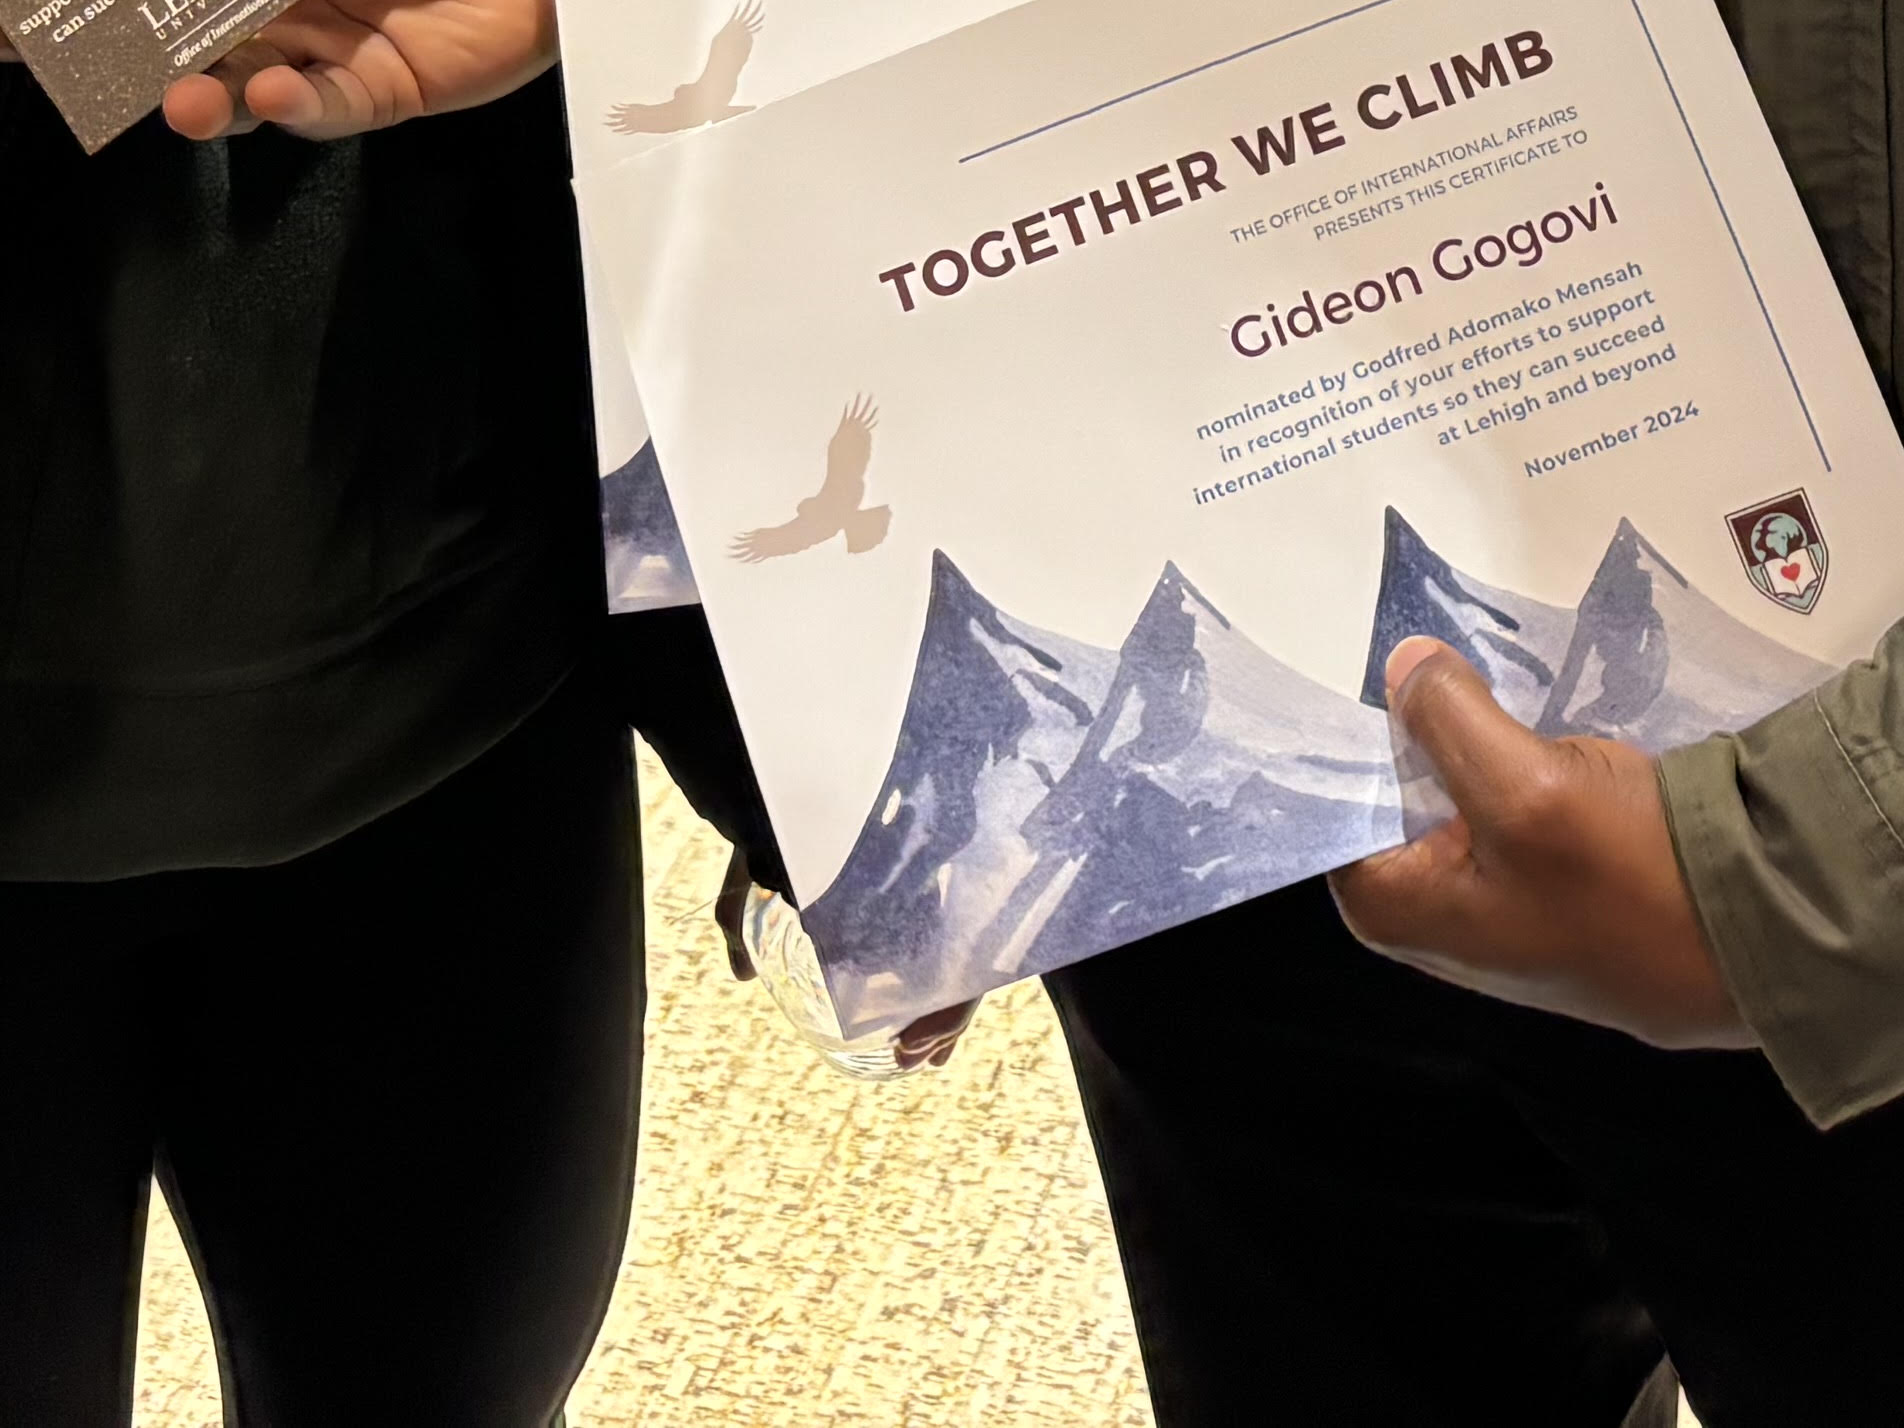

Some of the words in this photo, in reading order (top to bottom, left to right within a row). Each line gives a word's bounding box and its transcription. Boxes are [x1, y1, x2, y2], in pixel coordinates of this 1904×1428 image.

[52, 17, 85, 44] can
[174, 42, 203, 67] Office
[201, 32, 214, 48] of
[879, 150, 1226, 313] TOGETHER
[1230, 102, 1346, 177] WE
[1356, 29, 1554, 131] CLIMB
[1230, 220, 1267, 244] THE
[1269, 195, 1331, 229] OFFICE
[1334, 184, 1358, 204] OF
[1361, 132, 1504, 197] INTERNATIONAL
[1506, 105, 1579, 143] AFFAIRS
[1313, 195, 1404, 241] PRESENTS
[1406, 178, 1447, 204] THIS
[1448, 143, 1561, 191] CERTIFICATE
[1562, 129, 1588, 147] TO
[1230, 264, 1423, 358] Gideon
[1432, 181, 1619, 281] Gogovi
[1193, 442, 1337, 506] international
[1341, 400, 1439, 450] students
[1444, 389, 1468, 411] so
[1473, 370, 1523, 406] they
[1529, 356, 1568, 379] can
[1573, 315, 1666, 362] succeed
[1196, 383, 1315, 440] nominated
[1319, 373, 1347, 405] by
[1352, 332, 1441, 380] Godfred
[1448, 295, 1551, 345] Adomako
[1556, 261, 1644, 304] Mensah
[1219, 444, 1241, 463] in
[1247, 394, 1373, 455] recognition
[1378, 384, 1401, 404] of
[1405, 360, 1455, 399] your
[1461, 335, 1534, 372] efforts
[1537, 321, 1562, 343] to
[1567, 287, 1656, 338] support
[1437, 427, 1461, 447] at
[1465, 394, 1540, 436] Lehigh
[1547, 375, 1588, 404] and
[1592, 343, 1677, 390] beyond
[1524, 425, 1640, 478] November
[1643, 400, 1700, 436] 2024
